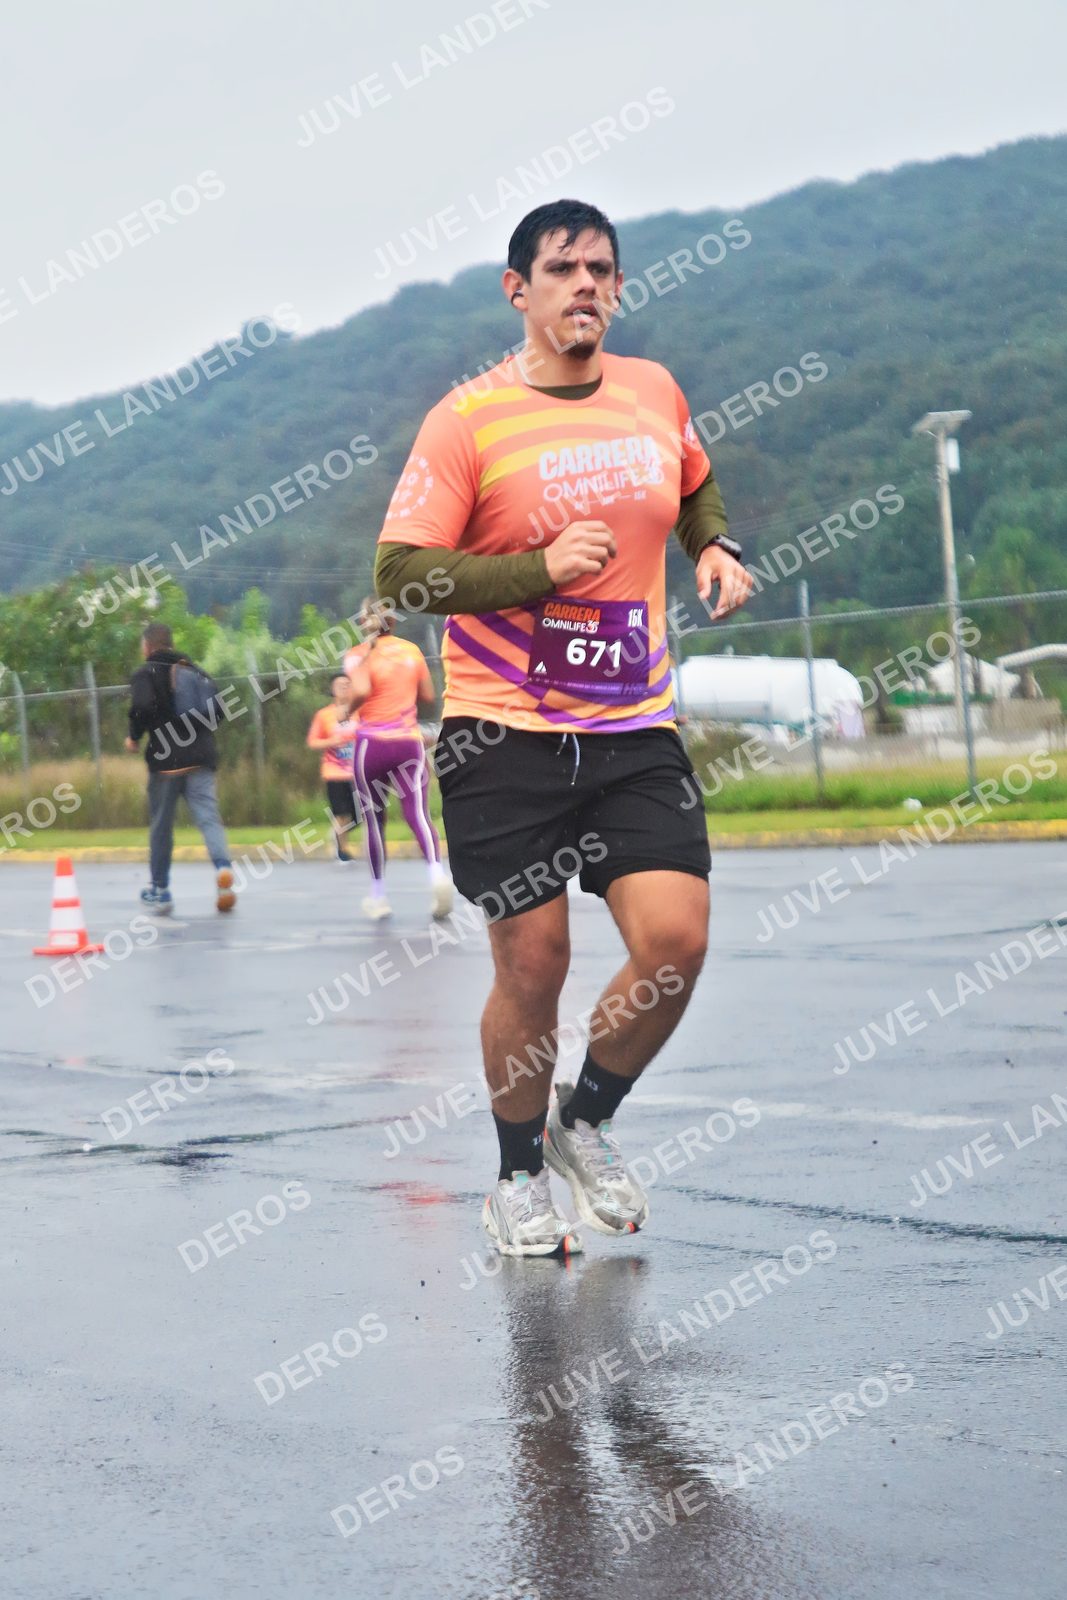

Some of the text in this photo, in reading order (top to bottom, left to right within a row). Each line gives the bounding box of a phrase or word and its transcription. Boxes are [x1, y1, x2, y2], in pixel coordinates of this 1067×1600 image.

[539, 435, 660, 480] CARRERA
[544, 602, 600, 621] CARRERA
[566, 637, 622, 668] 671
